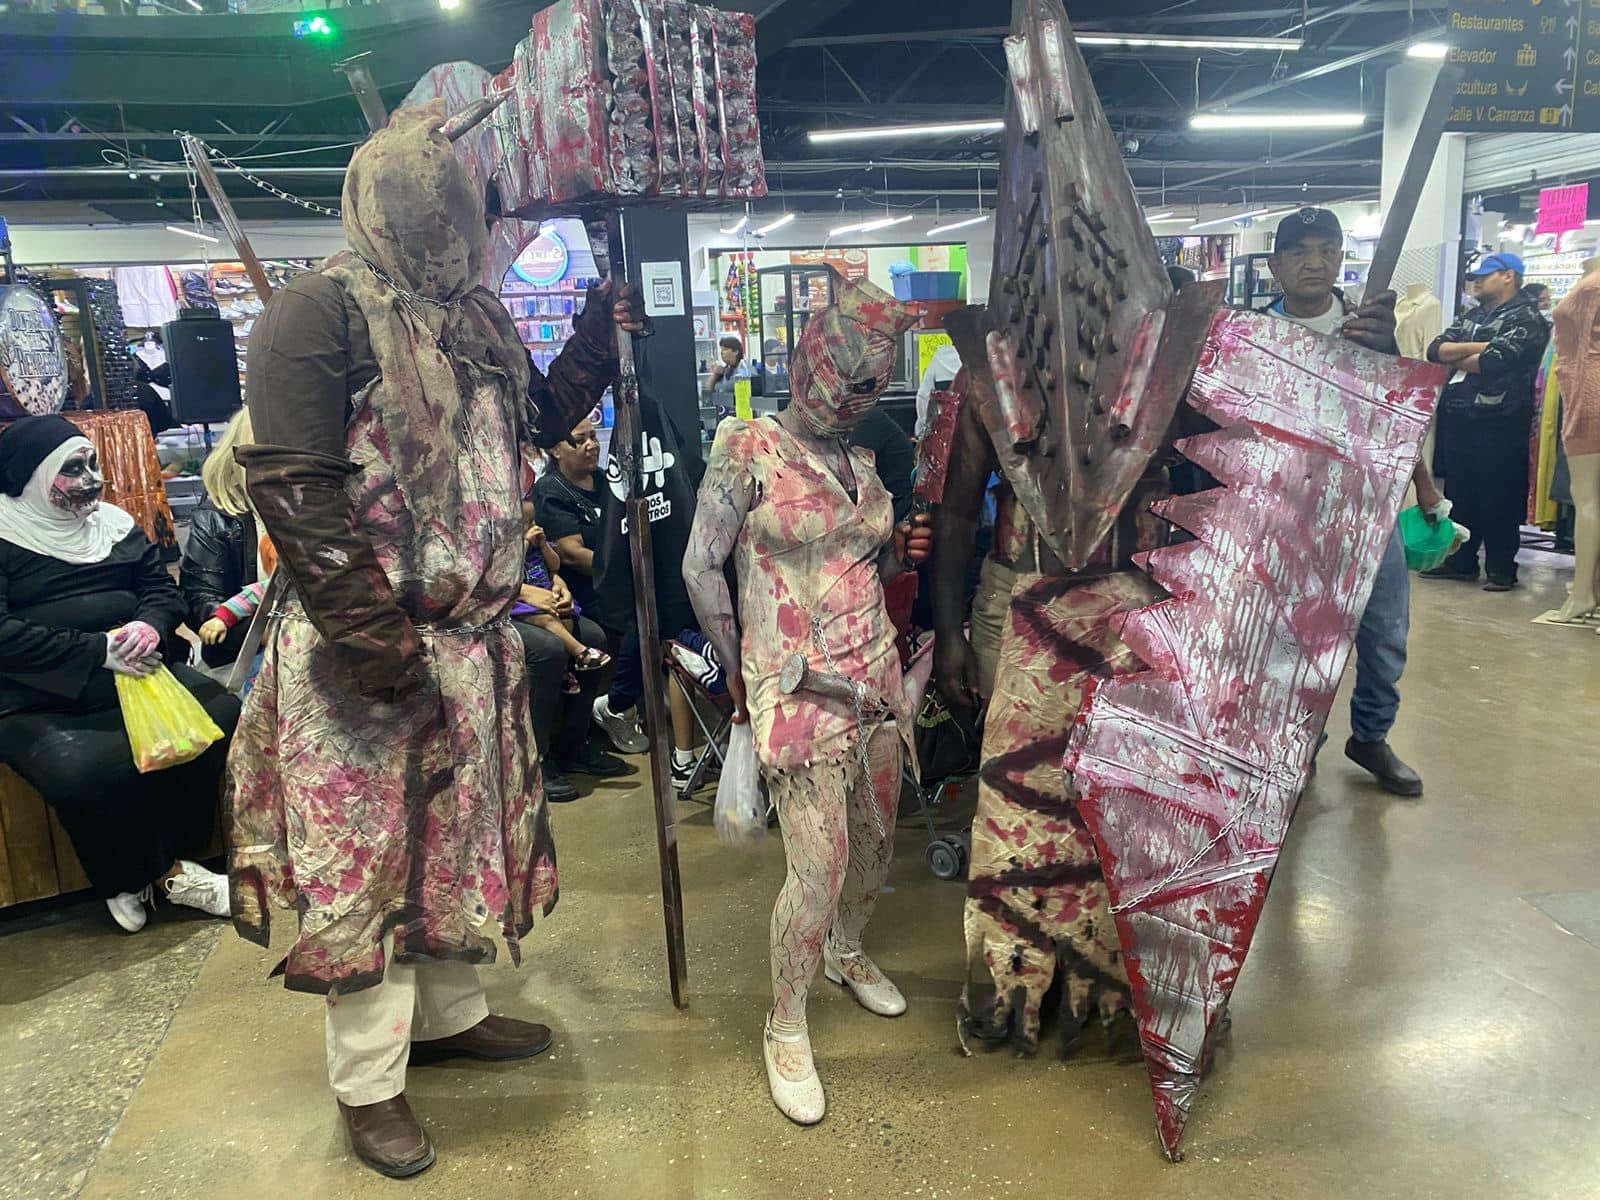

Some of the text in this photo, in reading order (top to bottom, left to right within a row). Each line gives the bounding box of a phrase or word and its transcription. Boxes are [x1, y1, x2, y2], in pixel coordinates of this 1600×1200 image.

[1452, 12, 1524, 31] Restaurantes
[1449, 47, 1496, 64] Elevador
[1456, 79, 1497, 95] scultura
[1488, 105, 1535, 122] Carranza
